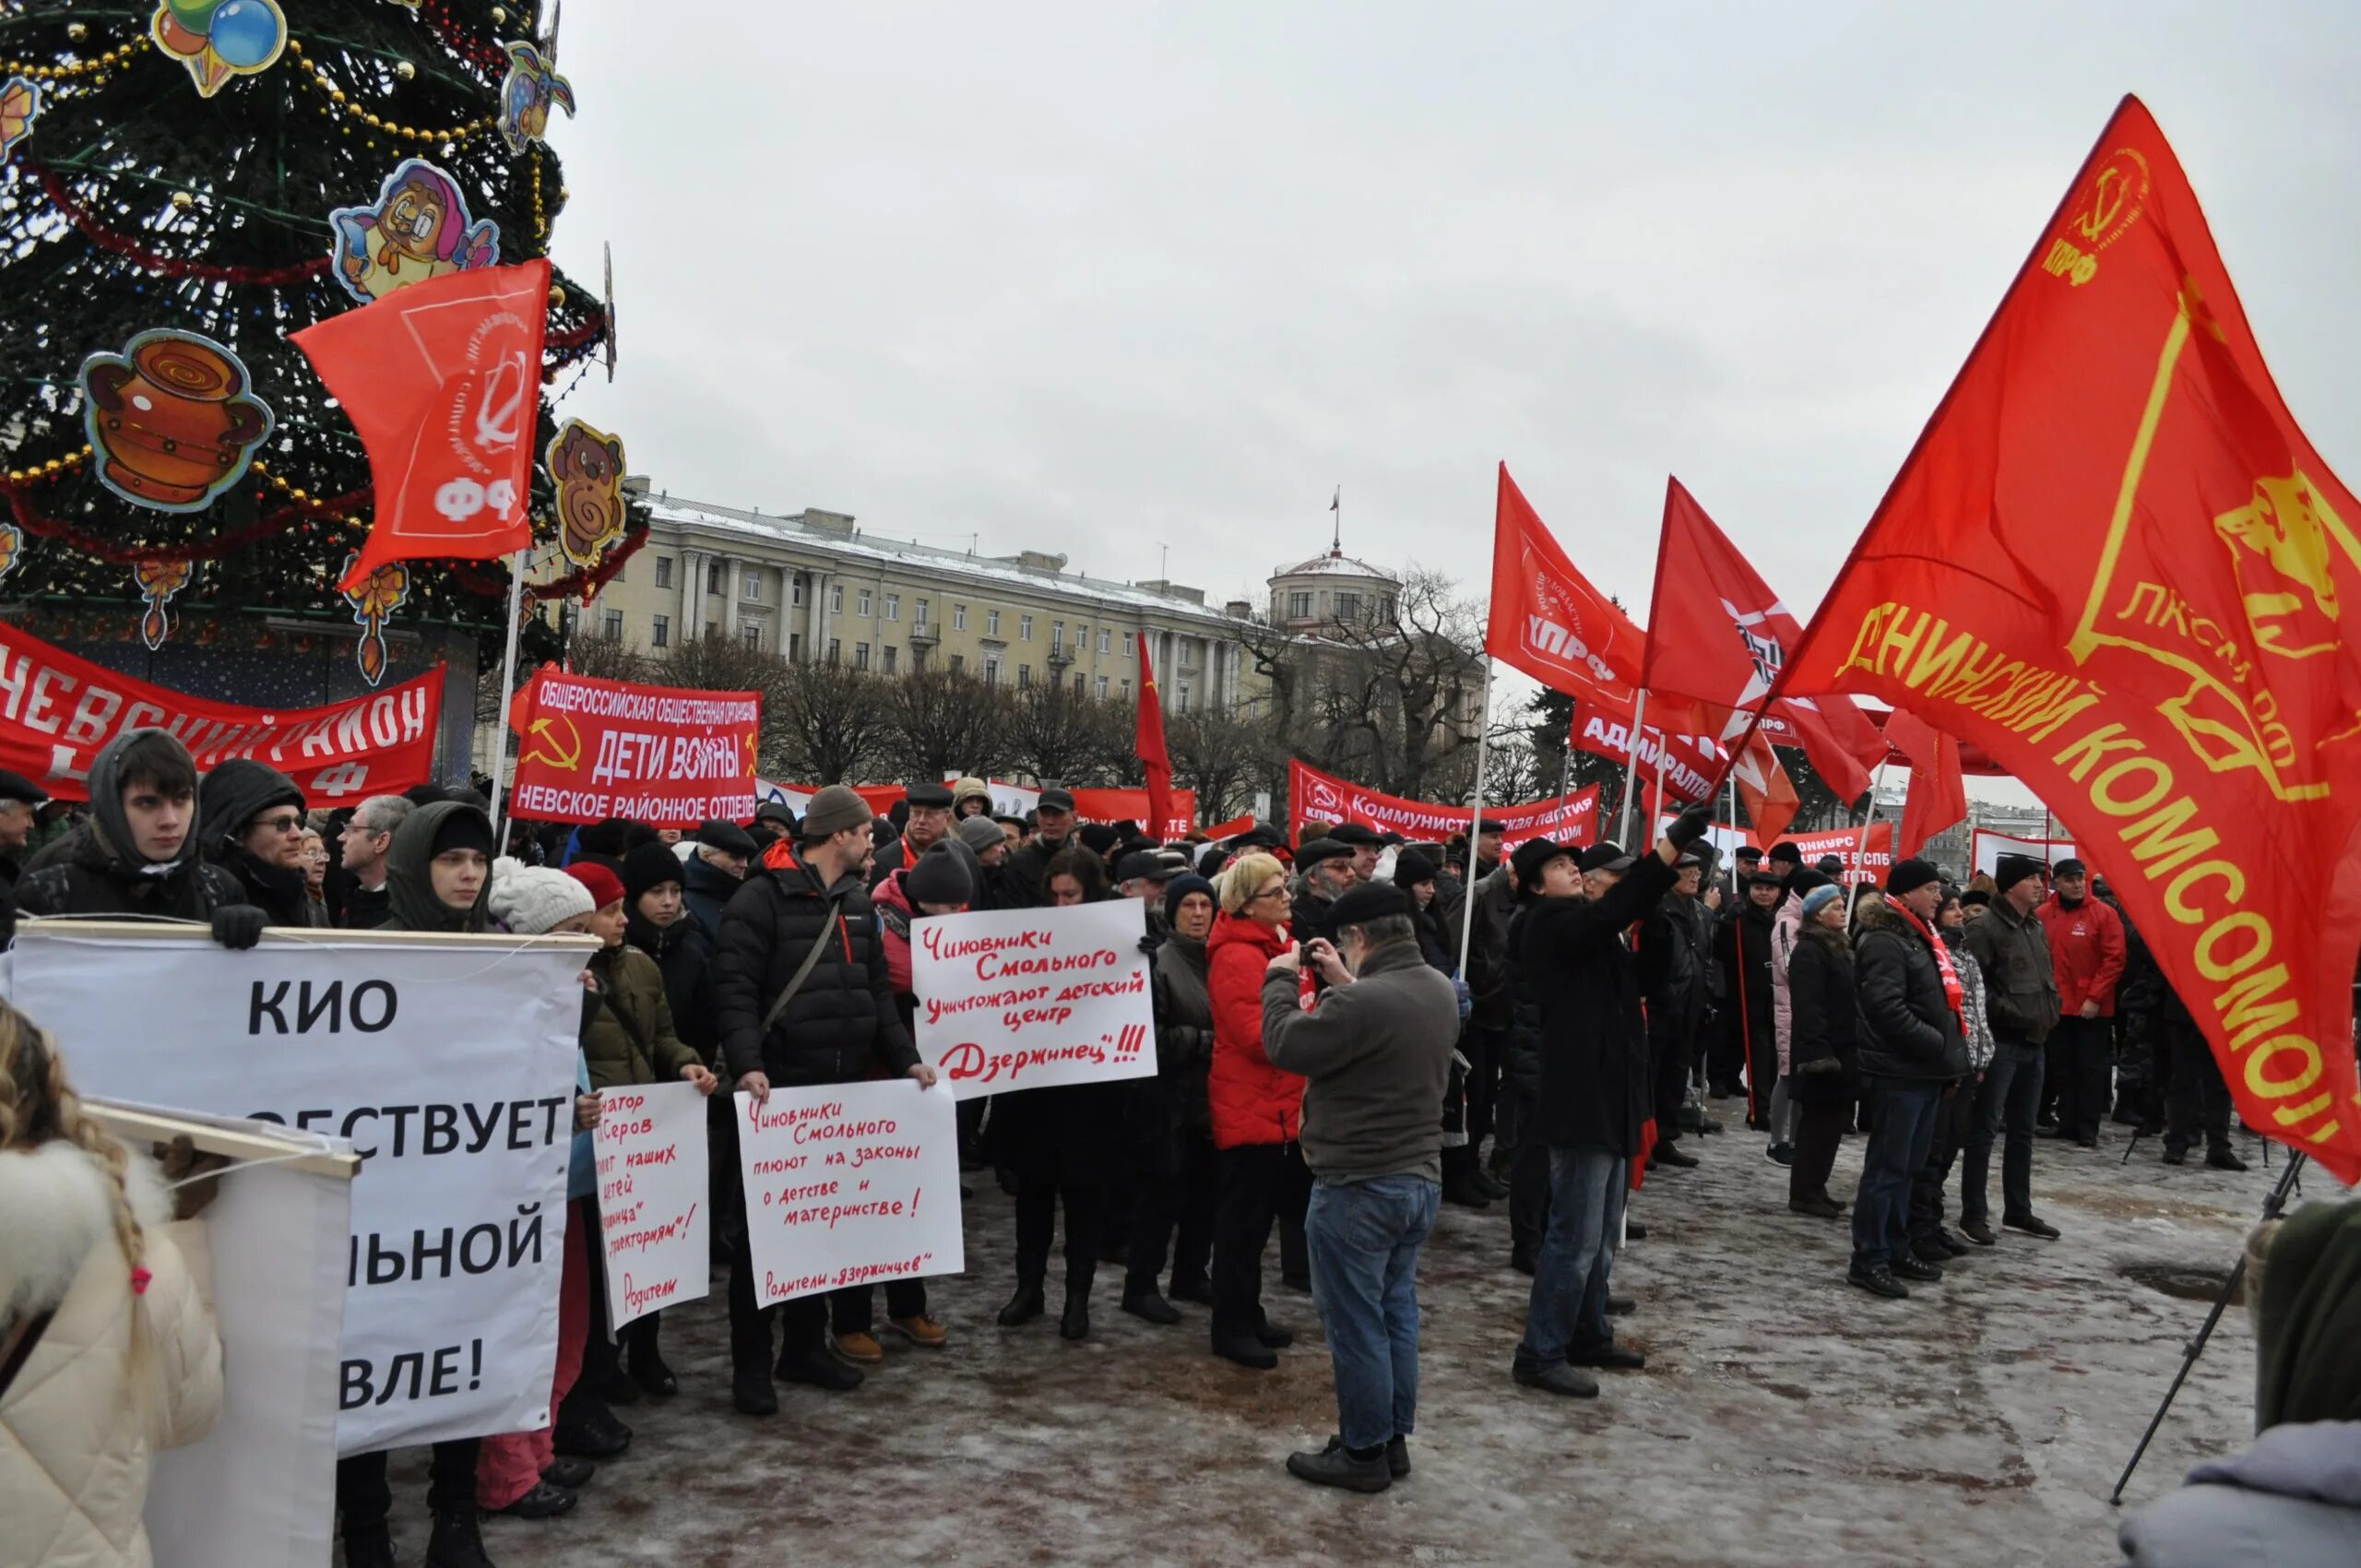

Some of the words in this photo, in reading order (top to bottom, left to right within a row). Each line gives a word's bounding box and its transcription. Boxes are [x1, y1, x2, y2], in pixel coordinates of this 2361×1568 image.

[540, 681, 655, 722] ОБЩЕРОССИЙСКАЯ
[1760, 718, 1786, 731] ПРФ
[591, 730, 668, 787] ДЕТИ
[669, 726, 740, 779] ВОЙНЫ
[516, 784, 610, 818] НЕВСКОЕ
[612, 791, 706, 821] РАЙОННОЕ
[1352, 793, 1533, 832] Коммунистская
[1797, 836, 1855, 851] ОНКУРС
[922, 926, 1052, 961] Чиновники
[976, 950, 1117, 981] Смольного
[1055, 970, 1145, 1002] детский
[249, 980, 397, 1035] КИО
[1003, 1006, 1072, 1032] центр
[601, 1095, 645, 1115] натор
[749, 1098, 842, 1134] Чиновники
[246, 1096, 566, 1159] СТВУЕТ
[794, 1120, 896, 1145] Смольного
[626, 1144, 676, 1168] наших
[753, 1156, 808, 1176] плюют
[825, 1151, 846, 1166] на
[764, 1192, 771, 1206] о
[778, 1181, 838, 1205] детстве
[859, 1180, 870, 1191] и
[623, 1272, 678, 1314] Родители
[766, 1270, 827, 1299] Родители
[339, 1338, 482, 1410] ВЛЕ!
